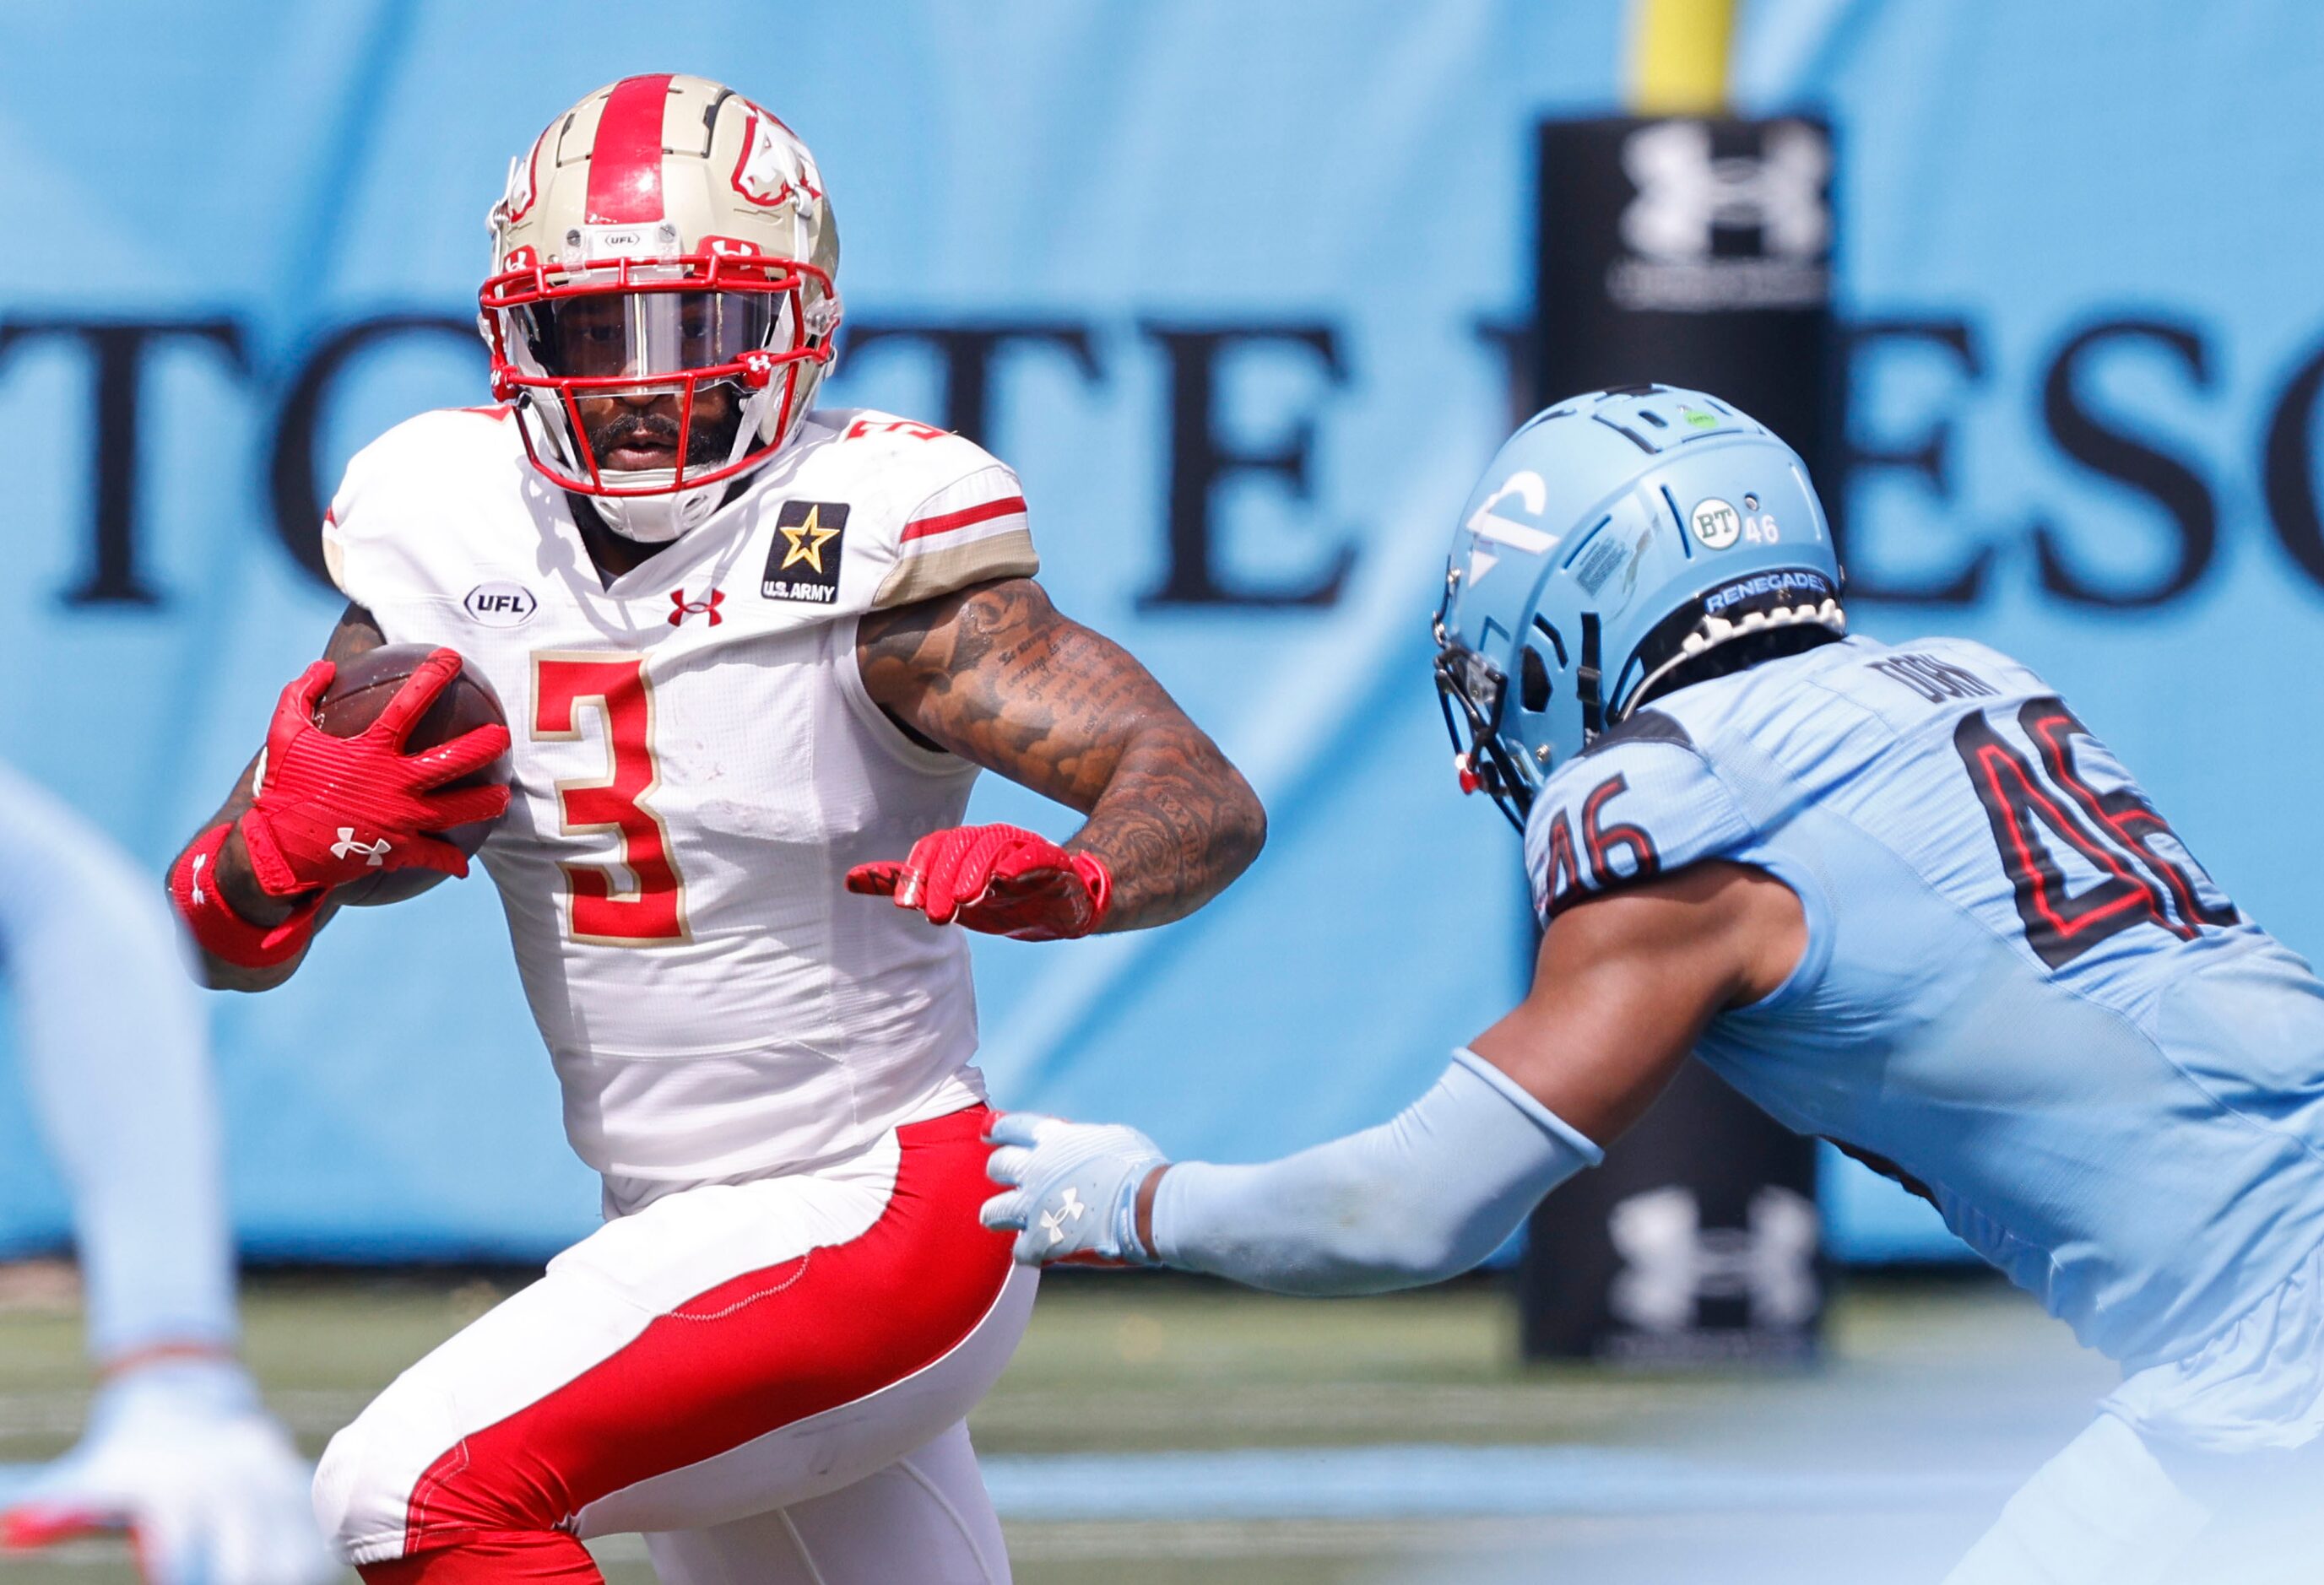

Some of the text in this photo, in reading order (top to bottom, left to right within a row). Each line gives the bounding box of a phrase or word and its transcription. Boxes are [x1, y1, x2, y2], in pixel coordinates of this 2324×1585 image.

[610, 235, 634, 245] UFL
[1697, 508, 1732, 539] BT
[1744, 515, 1780, 544] 46
[477, 595, 525, 613] UFL
[789, 582, 836, 602] ARMY
[1705, 572, 1827, 614] RENEGADES
[529, 650, 694, 948] 3
[1533, 770, 1661, 918] 46
[1953, 695, 2240, 970] 46
